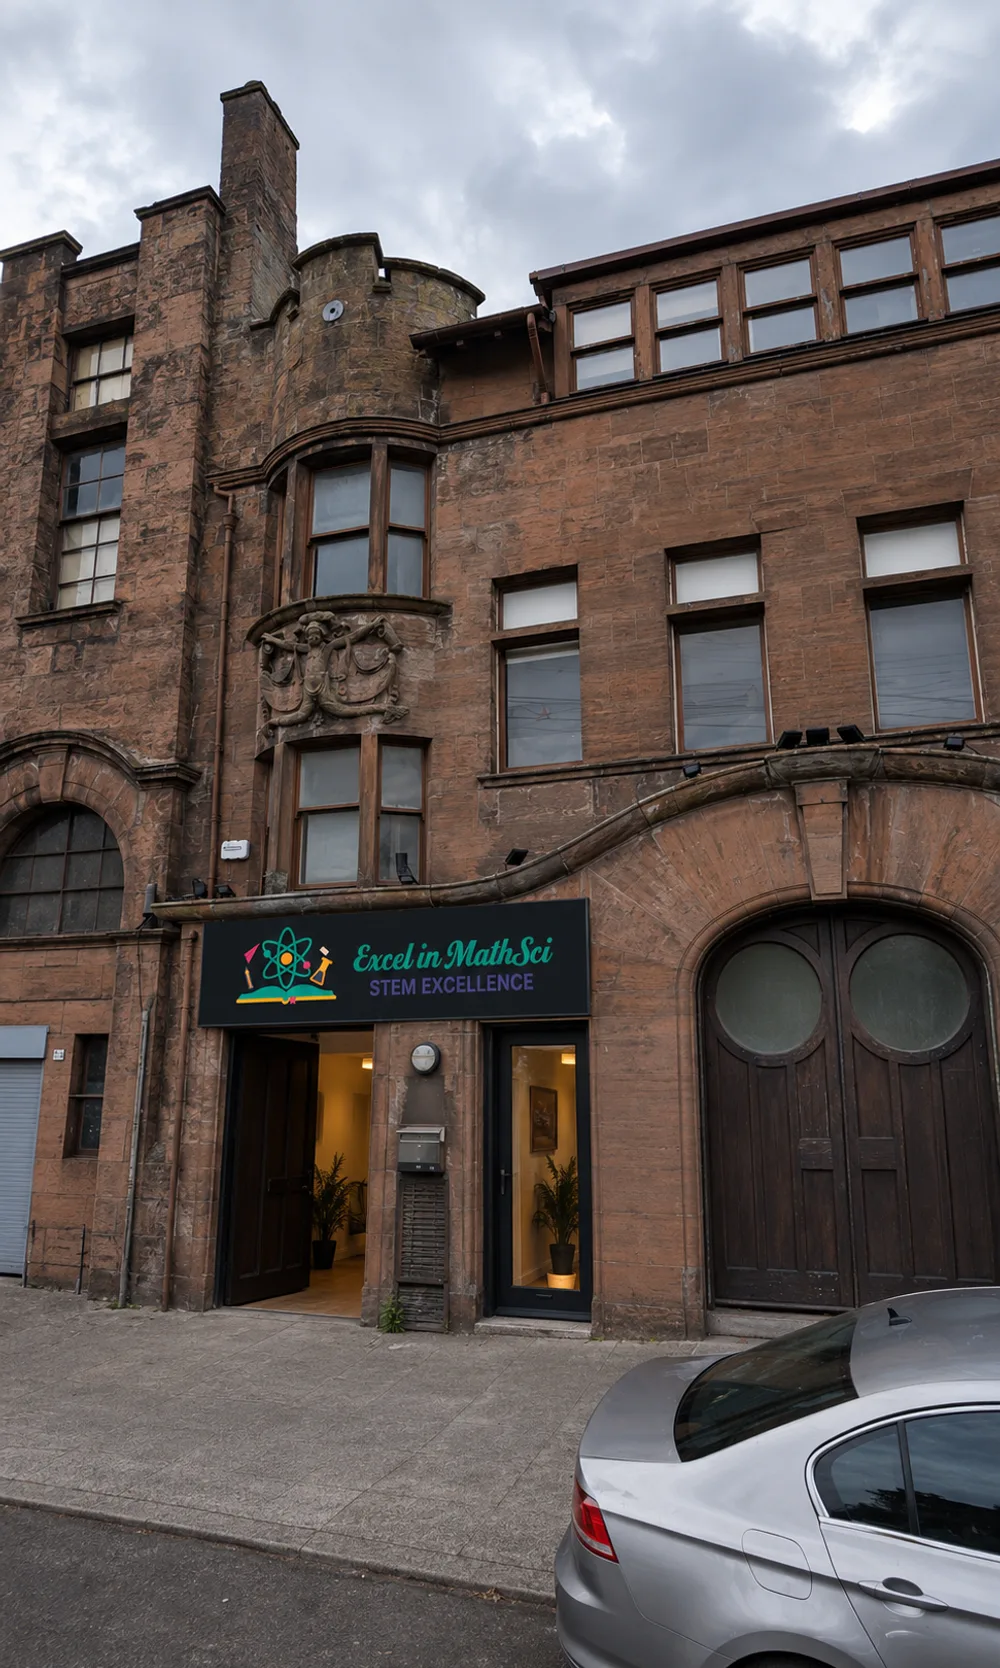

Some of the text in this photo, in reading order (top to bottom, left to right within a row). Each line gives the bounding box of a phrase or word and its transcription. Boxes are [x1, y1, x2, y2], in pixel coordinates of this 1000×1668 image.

[352, 935, 554, 973] Excel in MathSci
[369, 972, 534, 997] STEM EXCELLENCE
